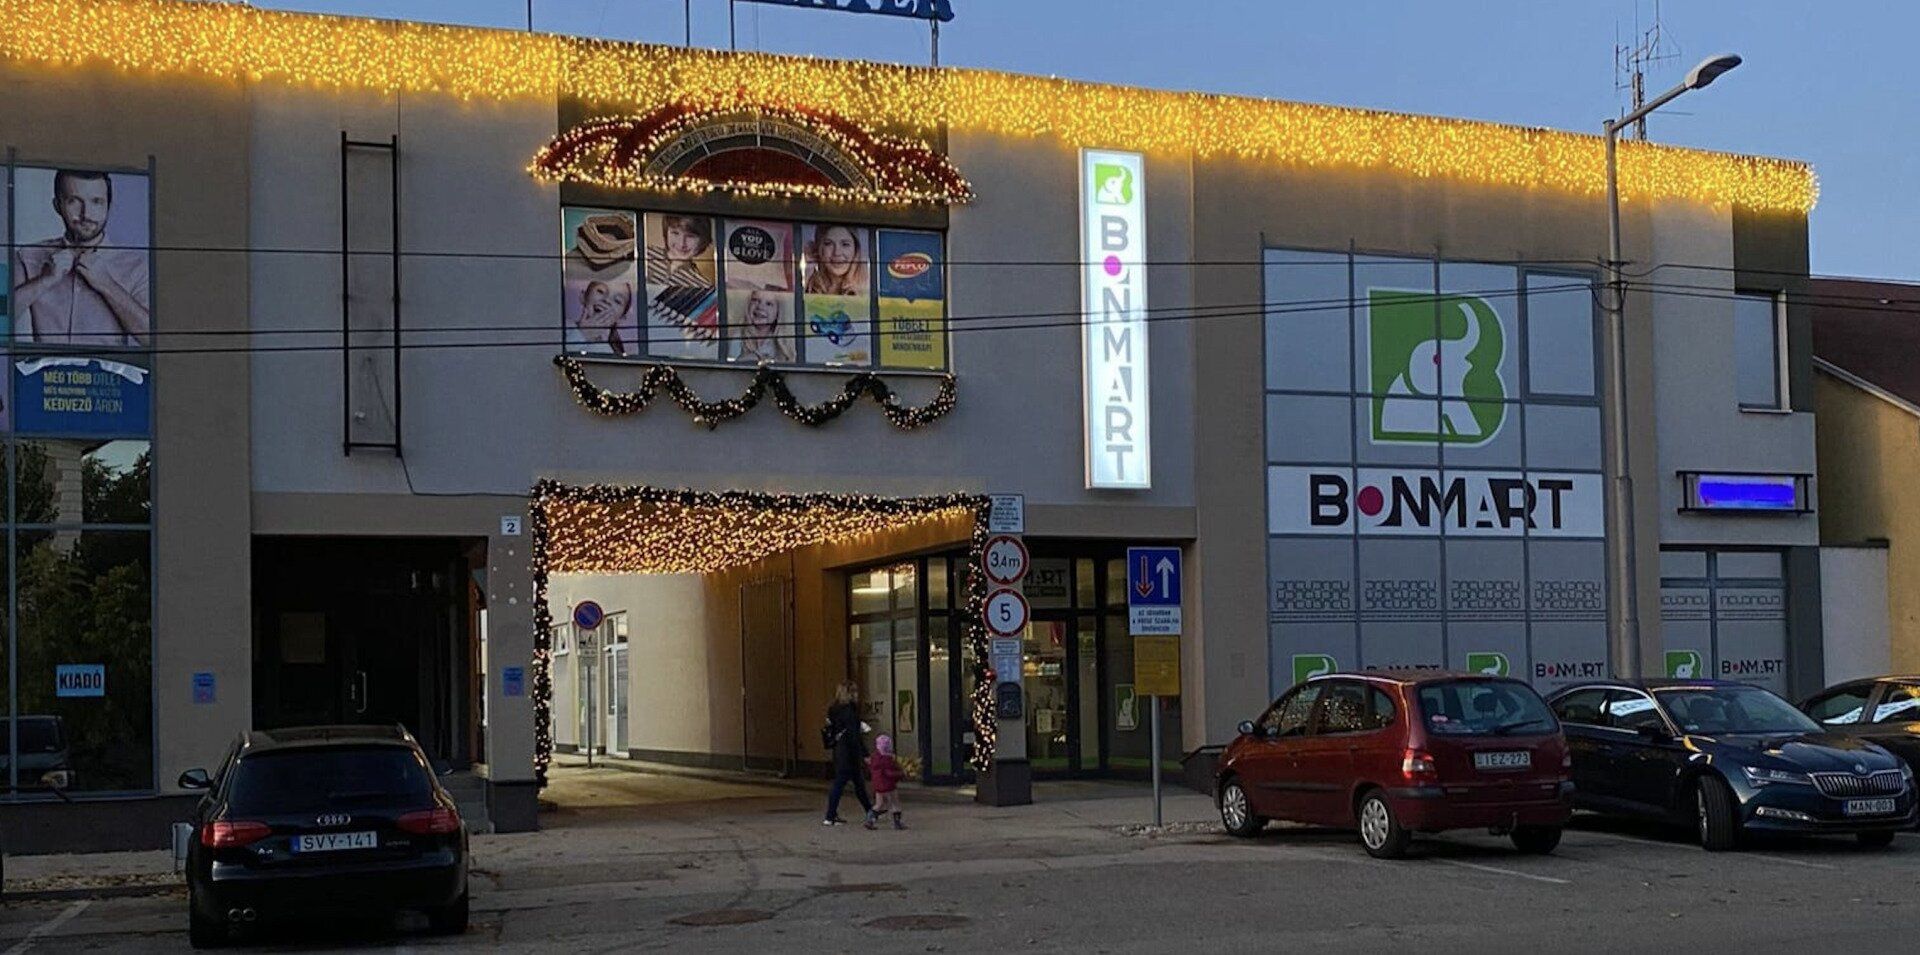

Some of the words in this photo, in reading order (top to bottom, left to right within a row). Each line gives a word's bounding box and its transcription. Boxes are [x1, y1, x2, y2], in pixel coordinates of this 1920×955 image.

[741, 234, 763, 245] YOU
[1100, 214, 1134, 481] BONMART
[1309, 474, 1573, 529] BONMART
[506, 522, 515, 533] 2
[1000, 602, 1011, 622] 5
[1721, 660, 1783, 675] BONMART
[59, 671, 101, 689] KIADÓ
[303, 834, 374, 850] SVY-141
